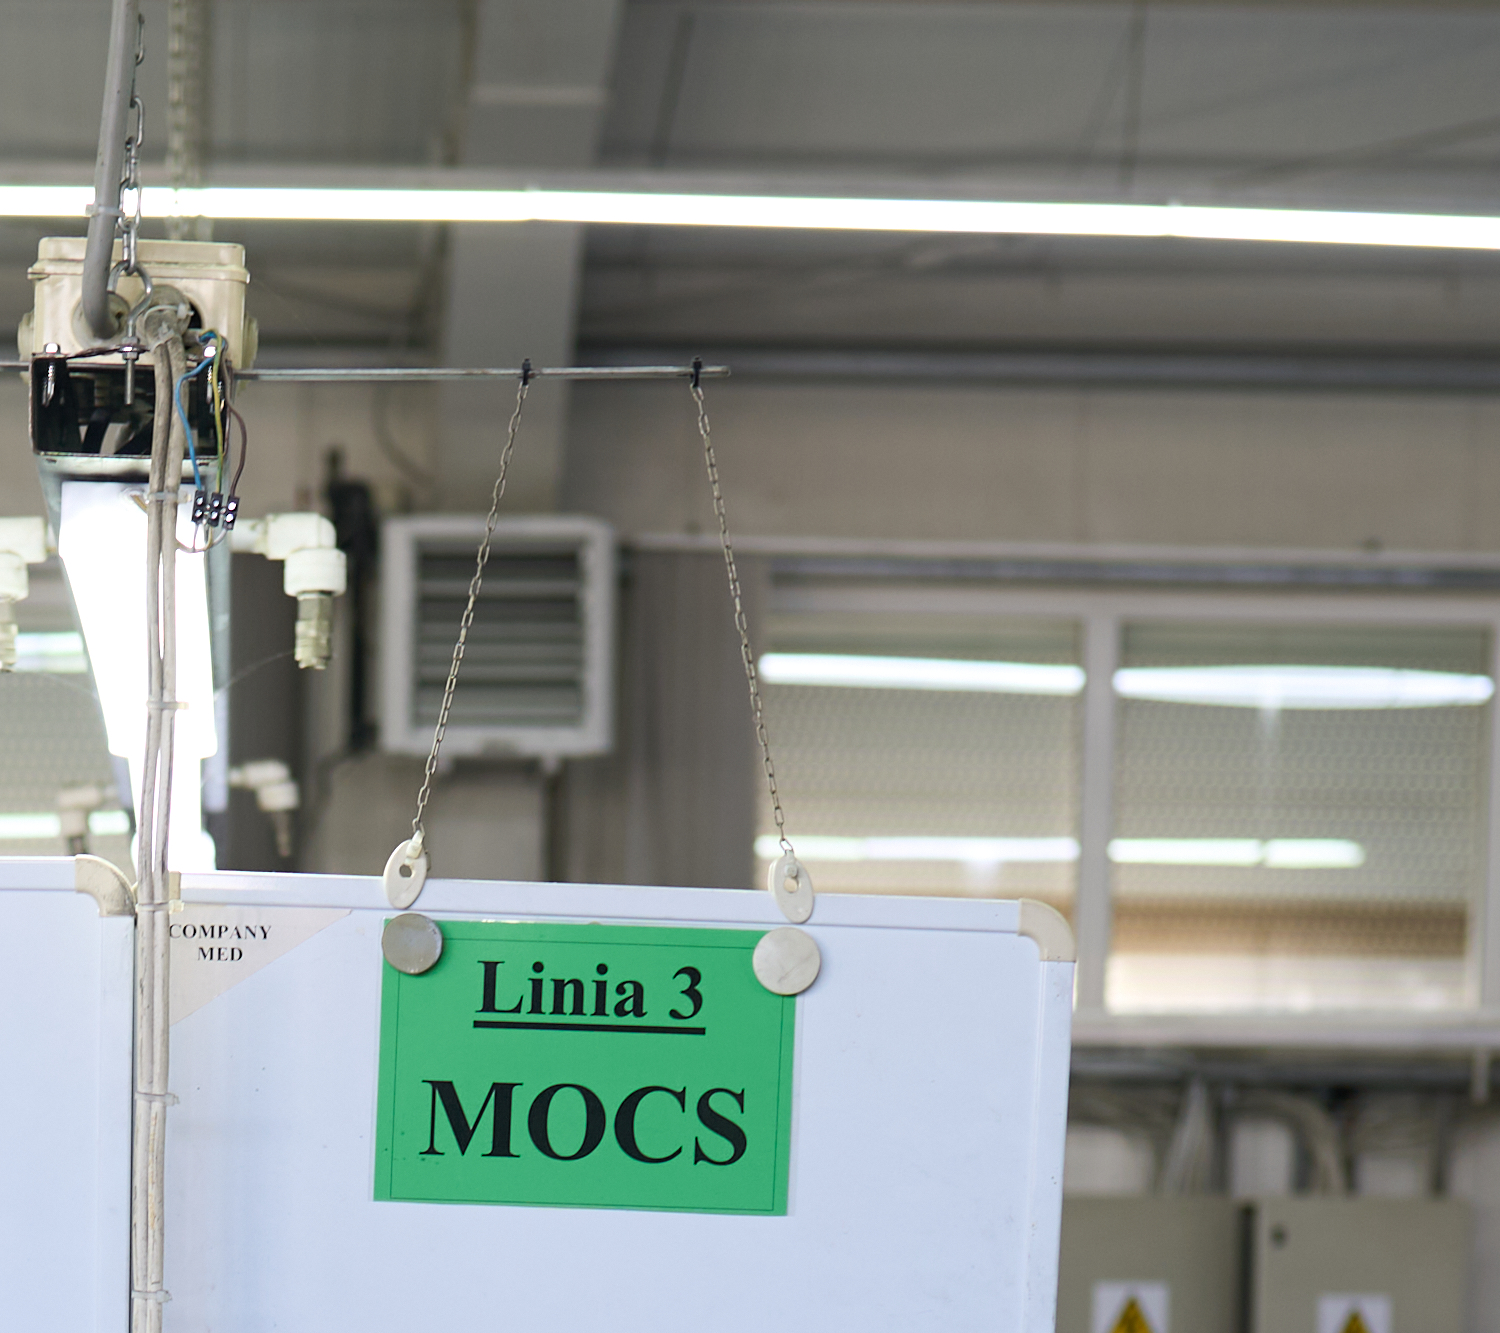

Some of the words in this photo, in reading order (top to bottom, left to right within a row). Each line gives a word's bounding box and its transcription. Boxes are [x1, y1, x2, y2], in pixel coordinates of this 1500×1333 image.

[169, 923, 272, 940] COMPANY
[198, 946, 243, 961] MED
[475, 960, 648, 1018] Linia
[668, 965, 704, 1020] 3
[419, 1079, 748, 1166] MOCS
